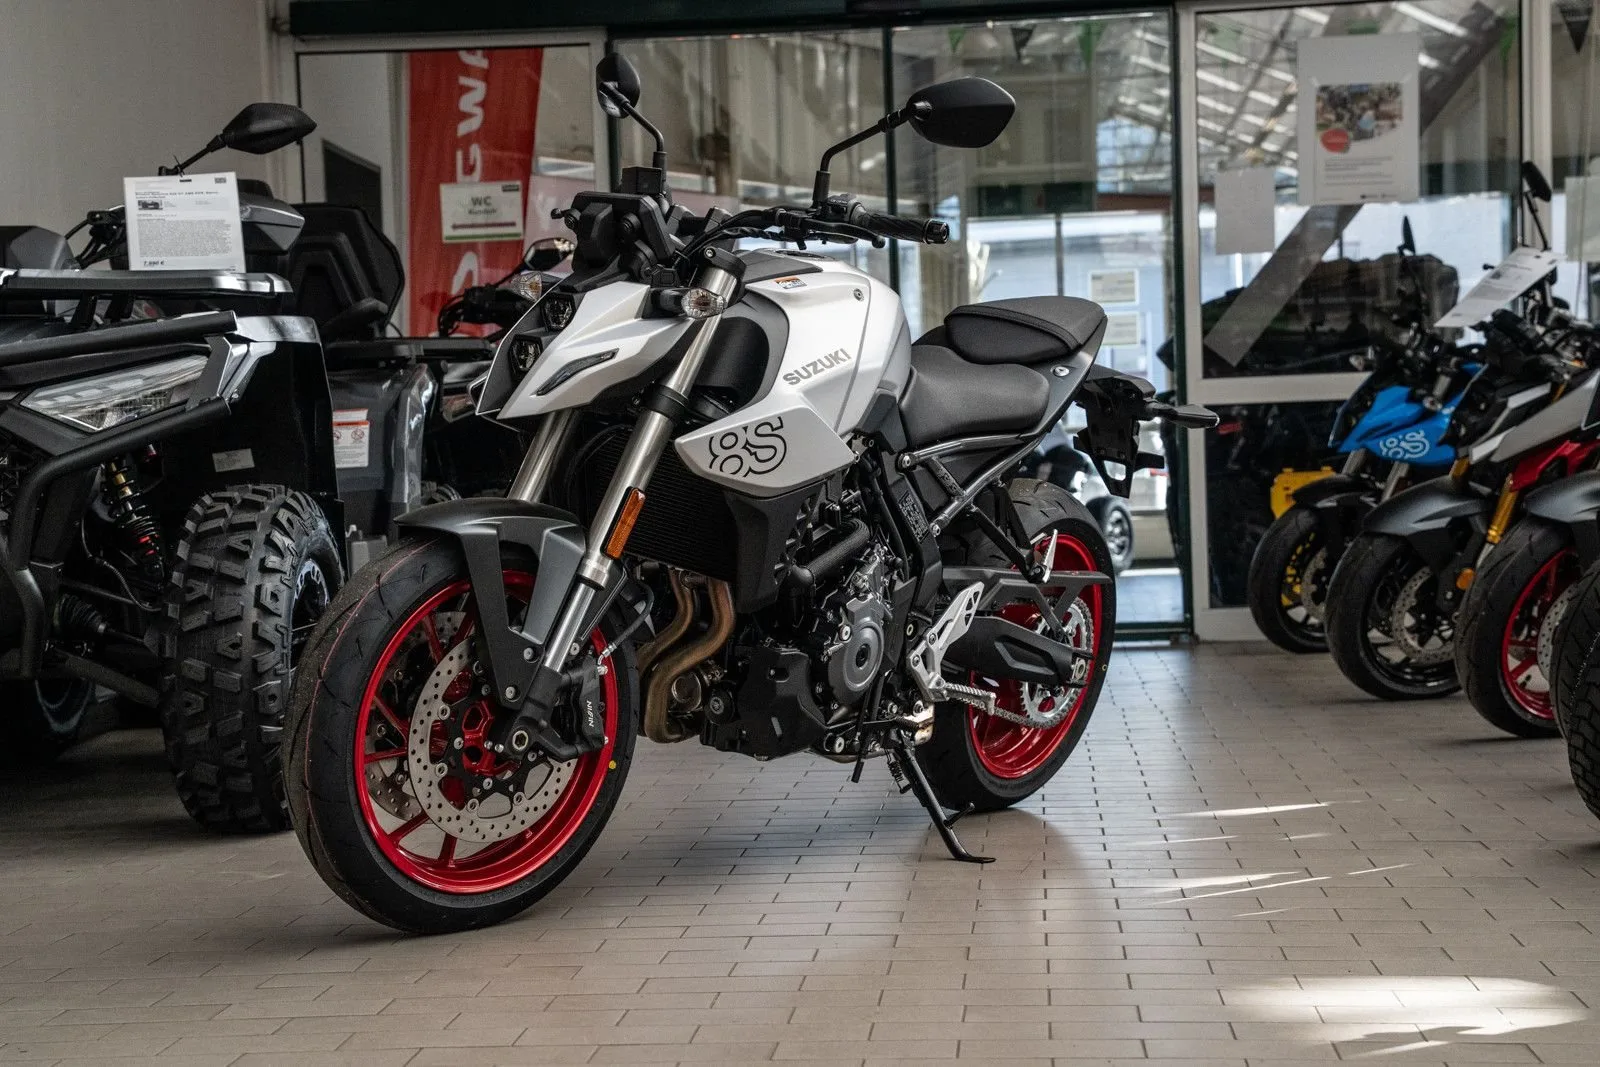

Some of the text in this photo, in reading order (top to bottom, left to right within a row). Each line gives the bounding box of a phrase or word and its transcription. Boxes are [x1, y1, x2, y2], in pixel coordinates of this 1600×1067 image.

[471, 196, 492, 206] WC
[782, 348, 852, 386] SUZUKI
[708, 416, 788, 478] 8S
